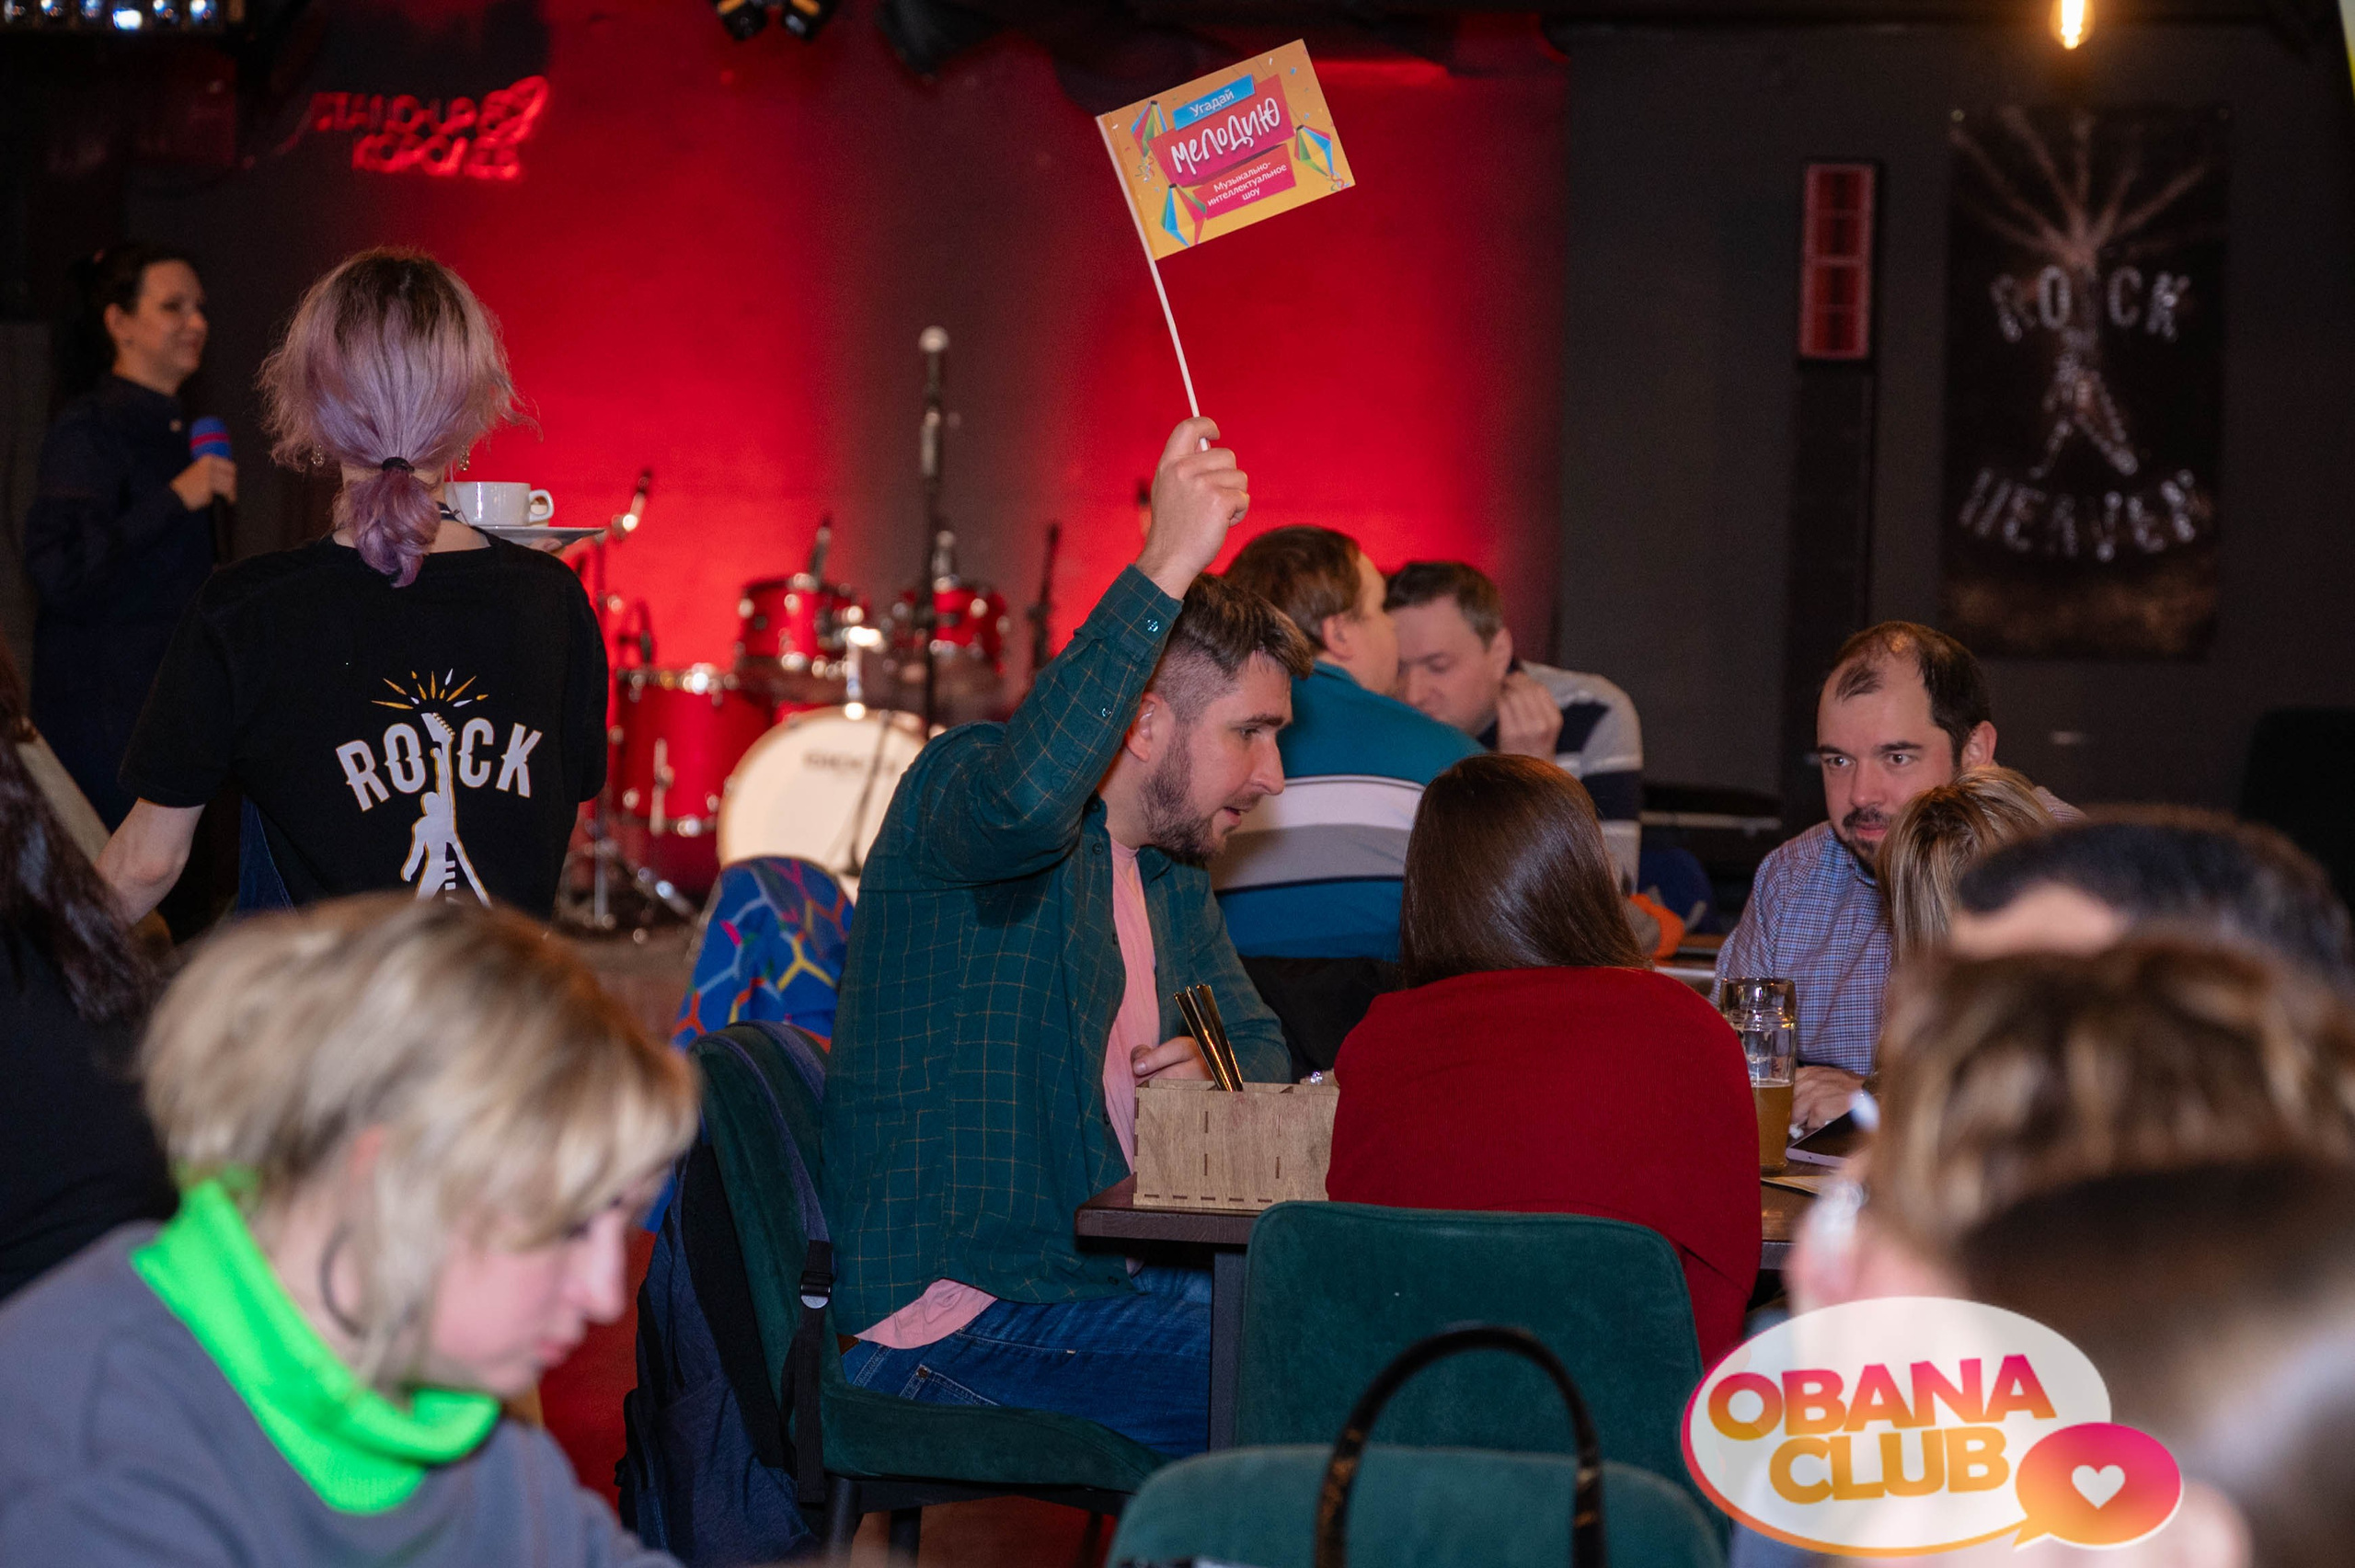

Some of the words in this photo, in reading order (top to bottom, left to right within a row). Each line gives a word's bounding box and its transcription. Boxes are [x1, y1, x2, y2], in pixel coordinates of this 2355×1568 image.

[1189, 88, 1235, 117] Угадай
[1207, 163, 1287, 207] интеллектуальное
[1213, 162, 1271, 192] Музыкально-
[1242, 187, 1260, 200] шоу
[1990, 264, 2191, 344] ROCK
[335, 717, 543, 812] ROCK
